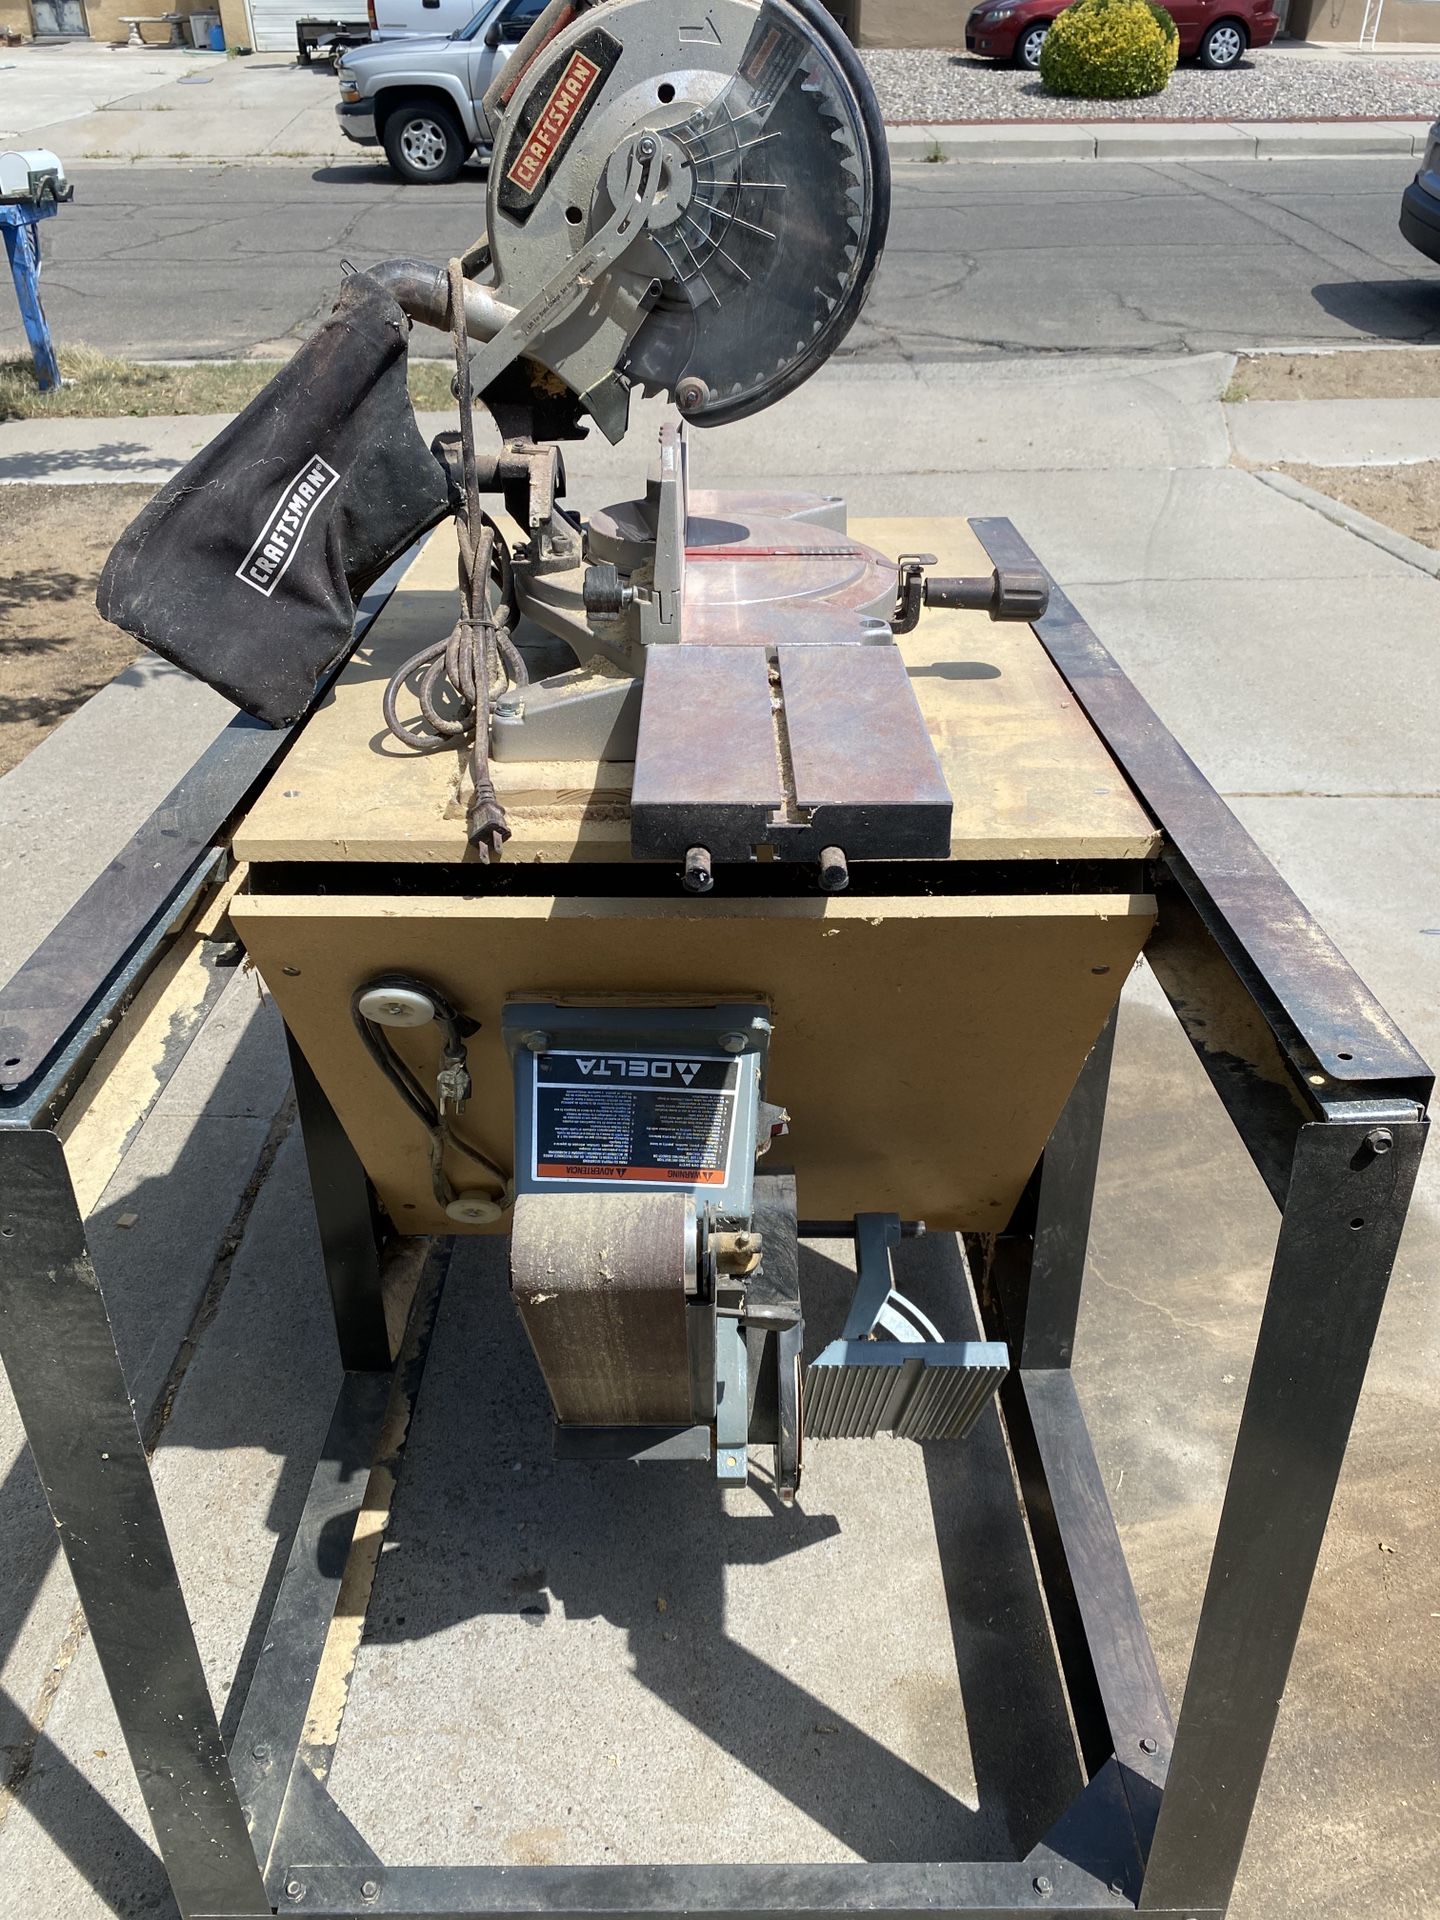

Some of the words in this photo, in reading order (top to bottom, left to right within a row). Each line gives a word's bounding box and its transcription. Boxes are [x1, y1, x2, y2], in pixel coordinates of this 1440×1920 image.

[517, 62, 591, 182] CRAFTSMAN
[575, 1058, 672, 1078] DELTA
[566, 1166, 615, 1176] ADVERTENCIA
[667, 1169, 701, 1179] WARNING
